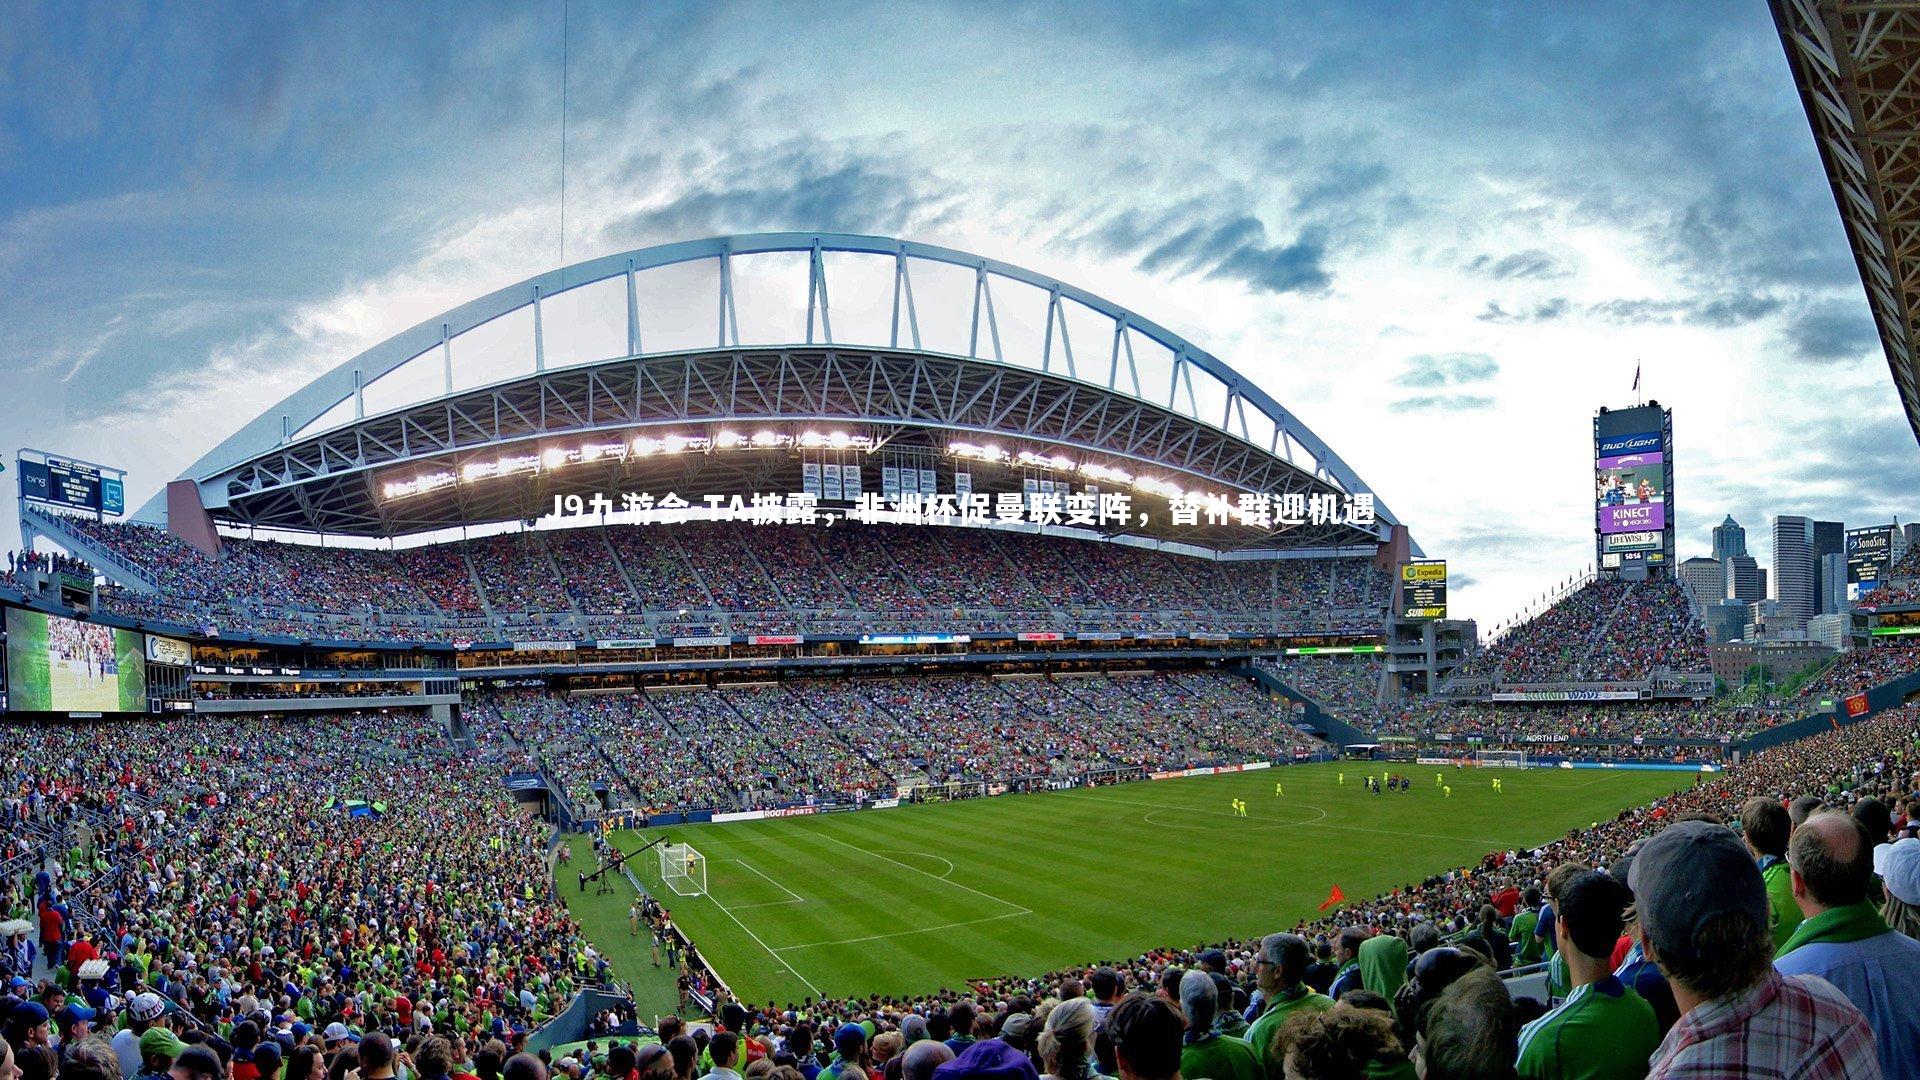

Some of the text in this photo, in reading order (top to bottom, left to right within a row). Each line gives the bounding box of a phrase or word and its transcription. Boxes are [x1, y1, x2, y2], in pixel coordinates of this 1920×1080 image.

[1602, 438, 1658, 450] BUD LIGHT
[26, 474, 46, 487] bing
[1613, 507, 1652, 519] KINECT
[1858, 536, 1886, 548] SonoSite
[1417, 569, 1442, 577] Expedia
[1405, 608, 1445, 617] SUBWAY
[518, 642, 566, 650] PINNACLE
[611, 640, 651, 648] walottery.com
[685, 638, 710, 646] Qwest
[1526, 734, 1569, 742] NORTH END
[764, 808, 786, 818] ROOT
[786, 806, 813, 816] SPORTS
